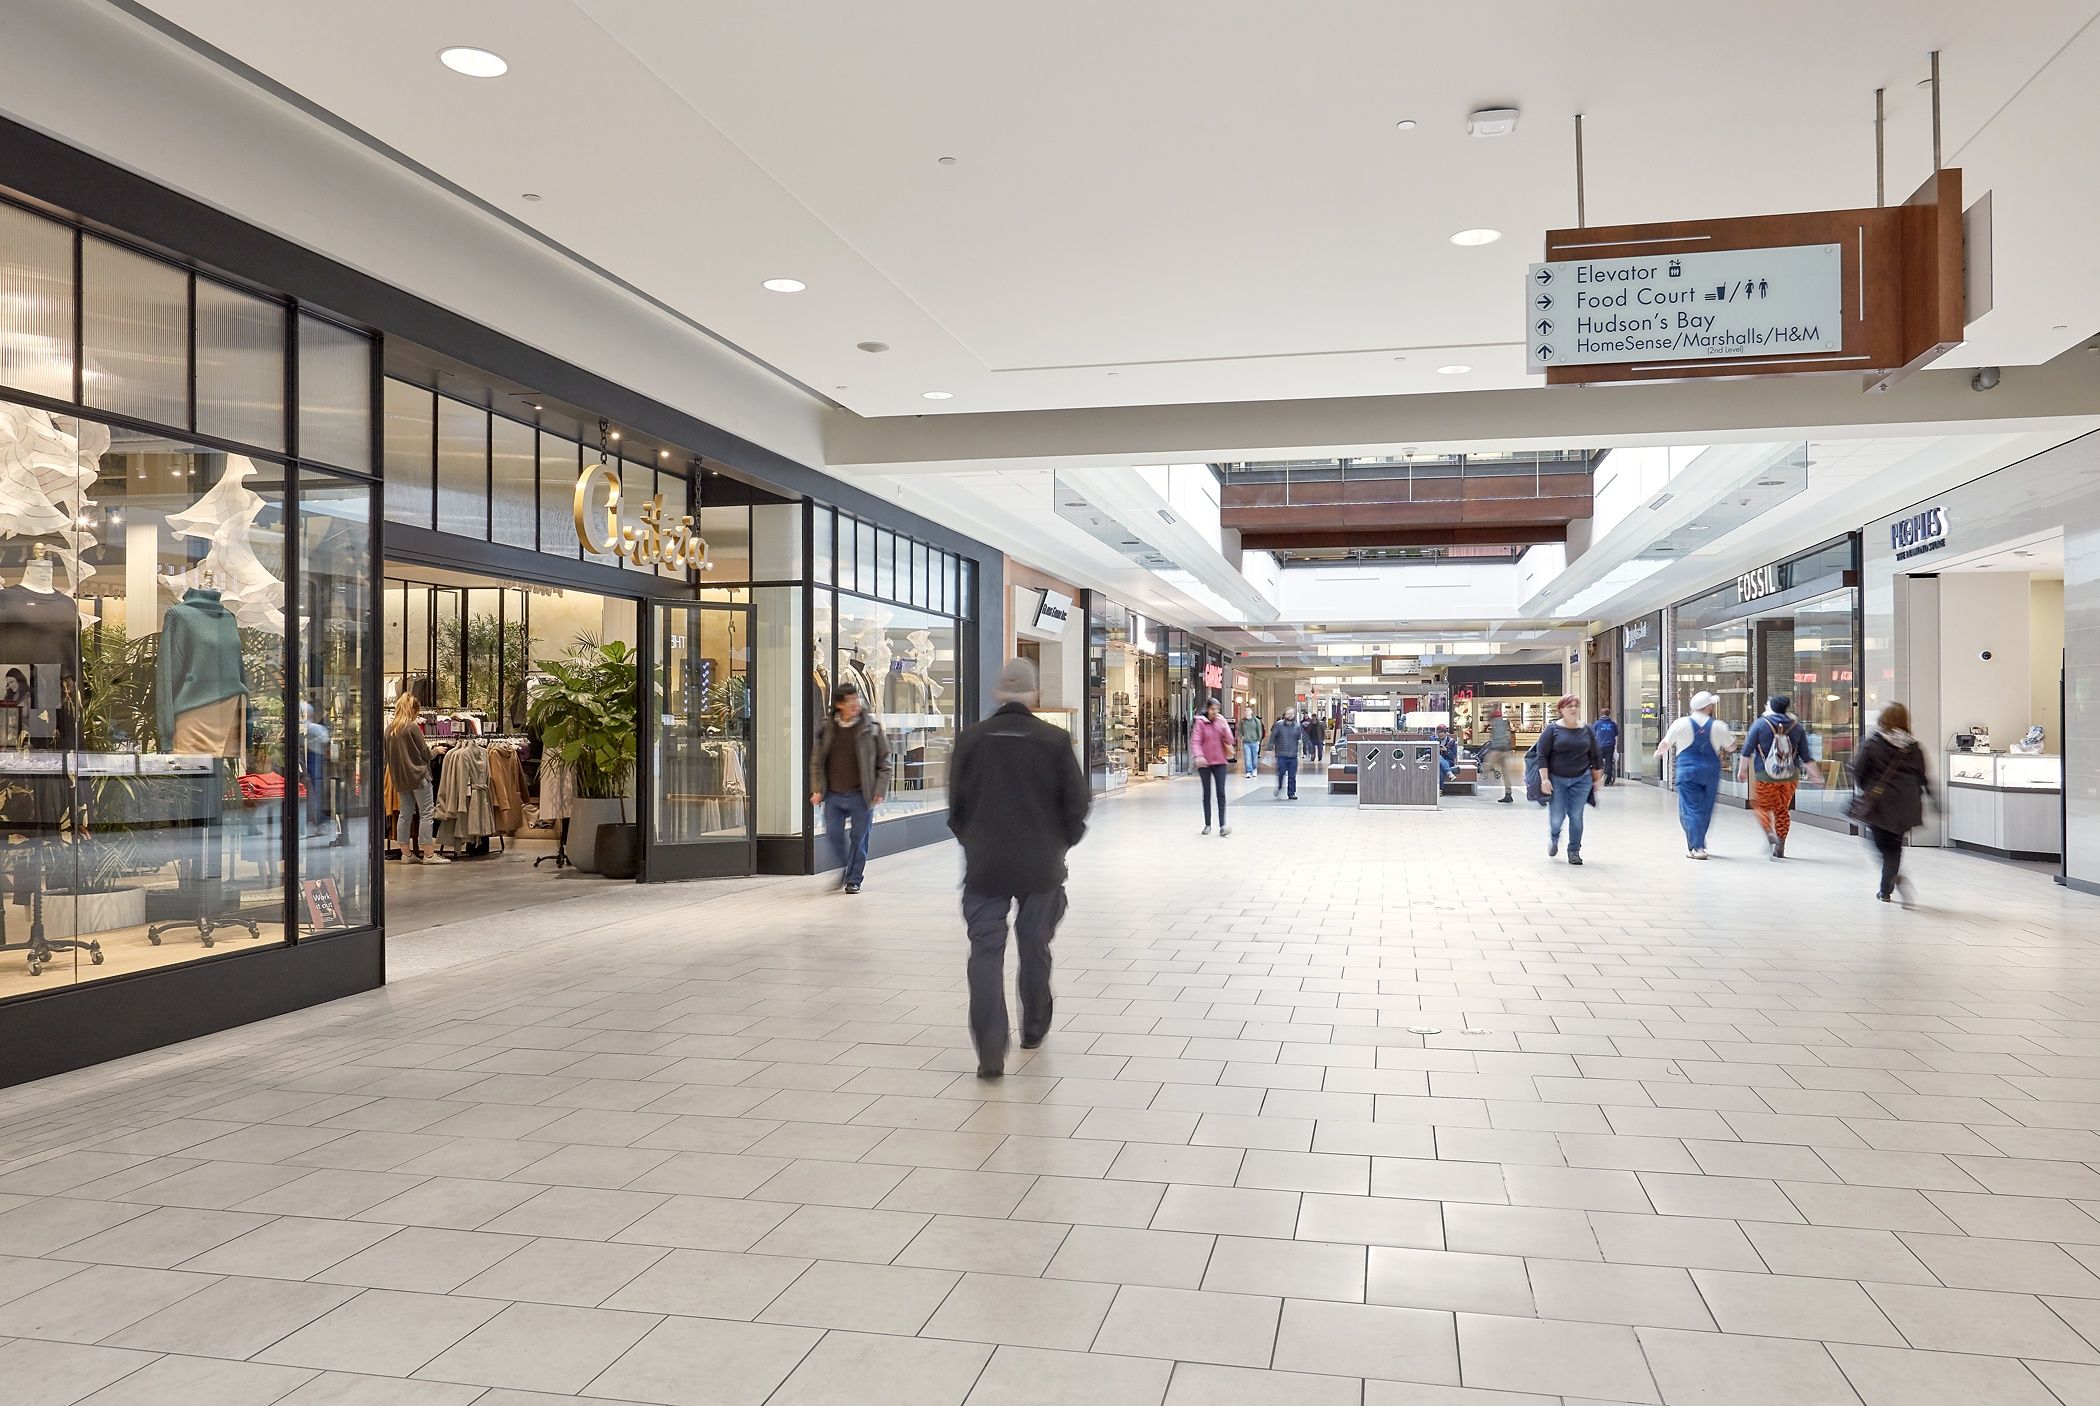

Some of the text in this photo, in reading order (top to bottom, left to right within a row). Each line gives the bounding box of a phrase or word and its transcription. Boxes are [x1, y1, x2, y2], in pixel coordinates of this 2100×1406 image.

[1577, 264, 1657, 283] Elevator
[1577, 286, 1695, 309] Food Court
[1577, 312, 1716, 334] Hudson's Bay
[1577, 325, 1820, 354] HomeSense/Marshalls/H&M
[1737, 564, 1776, 603] FOSSIL
[312, 893, 331, 902] Work
